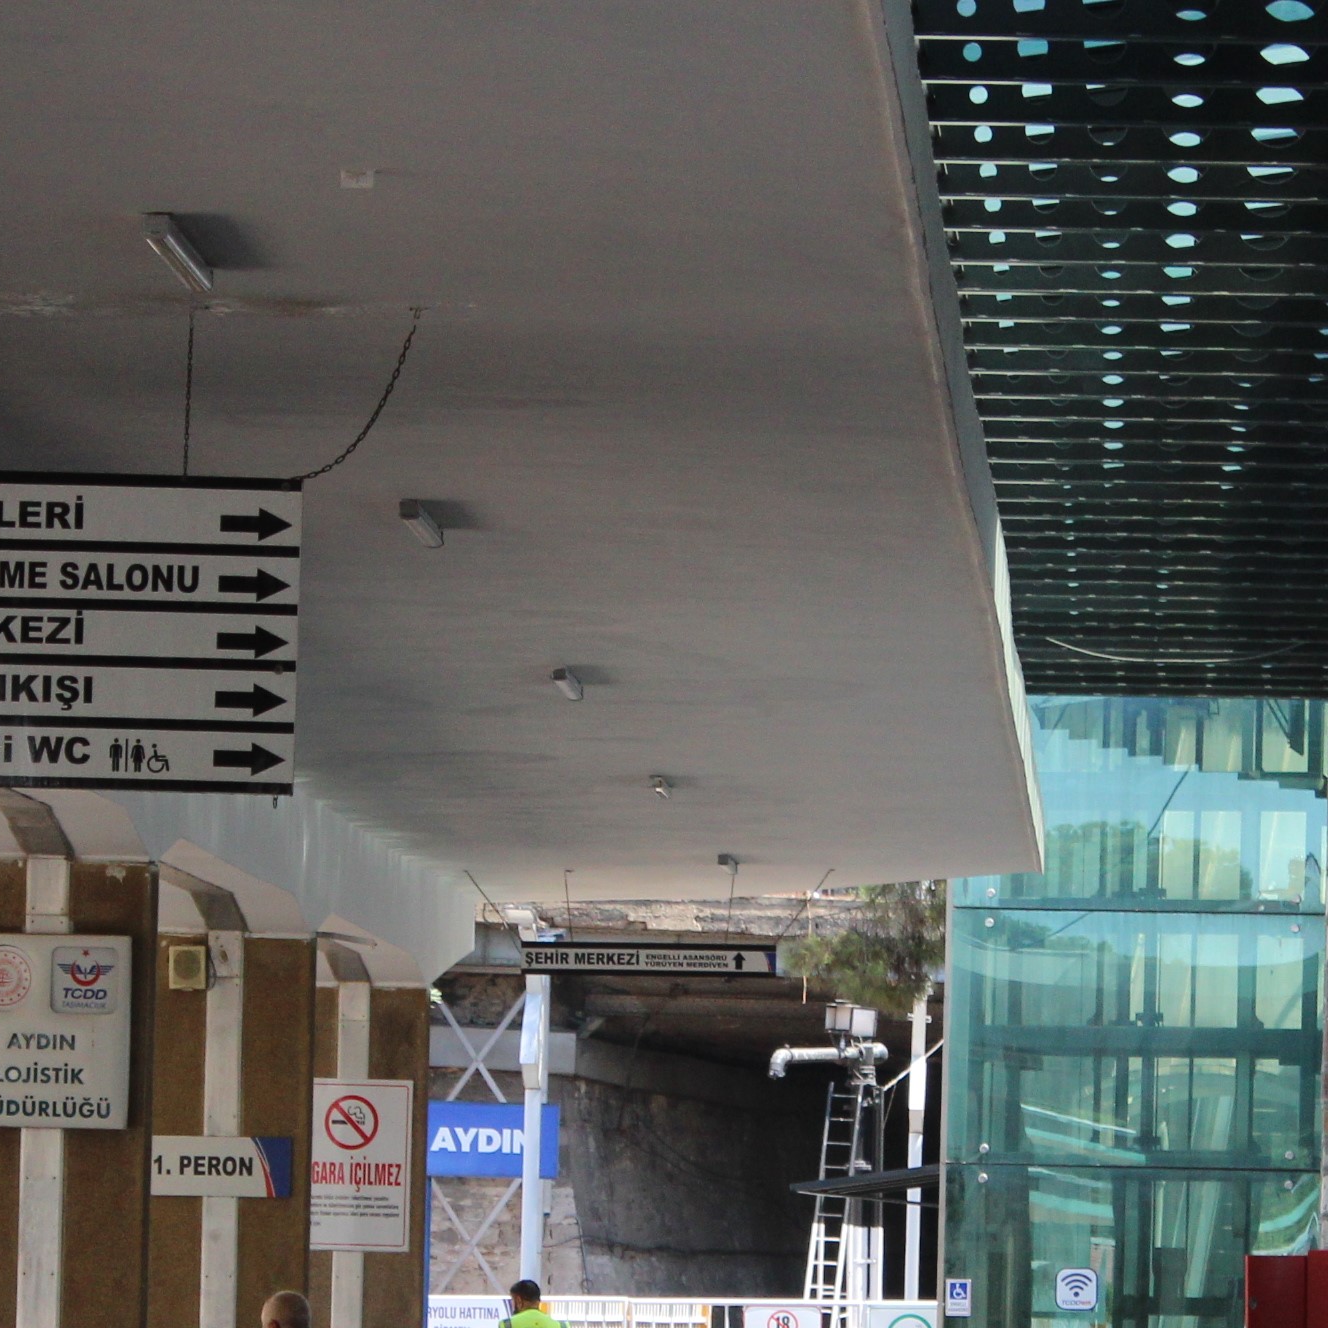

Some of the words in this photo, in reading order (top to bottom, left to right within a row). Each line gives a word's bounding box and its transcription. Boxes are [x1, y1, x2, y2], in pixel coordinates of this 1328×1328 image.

[60, 562, 200, 593] SALONU
[29, 737, 90, 765] WC
[525, 950, 569, 966] ŞEHİR
[574, 951, 640, 966] MERKEZİ
[63, 988, 107, 1000] TCDD
[7, 1033, 76, 1050] AYDIN
[153, 1155, 171, 1175] 1.
[179, 1155, 253, 1176] PERON
[311, 1162, 345, 1185] GARA
[349, 1156, 401, 1192] İÇİLMEZ
[427, 1307, 457, 1320] RYOLU
[459, 1307, 500, 1320] HATTINA
